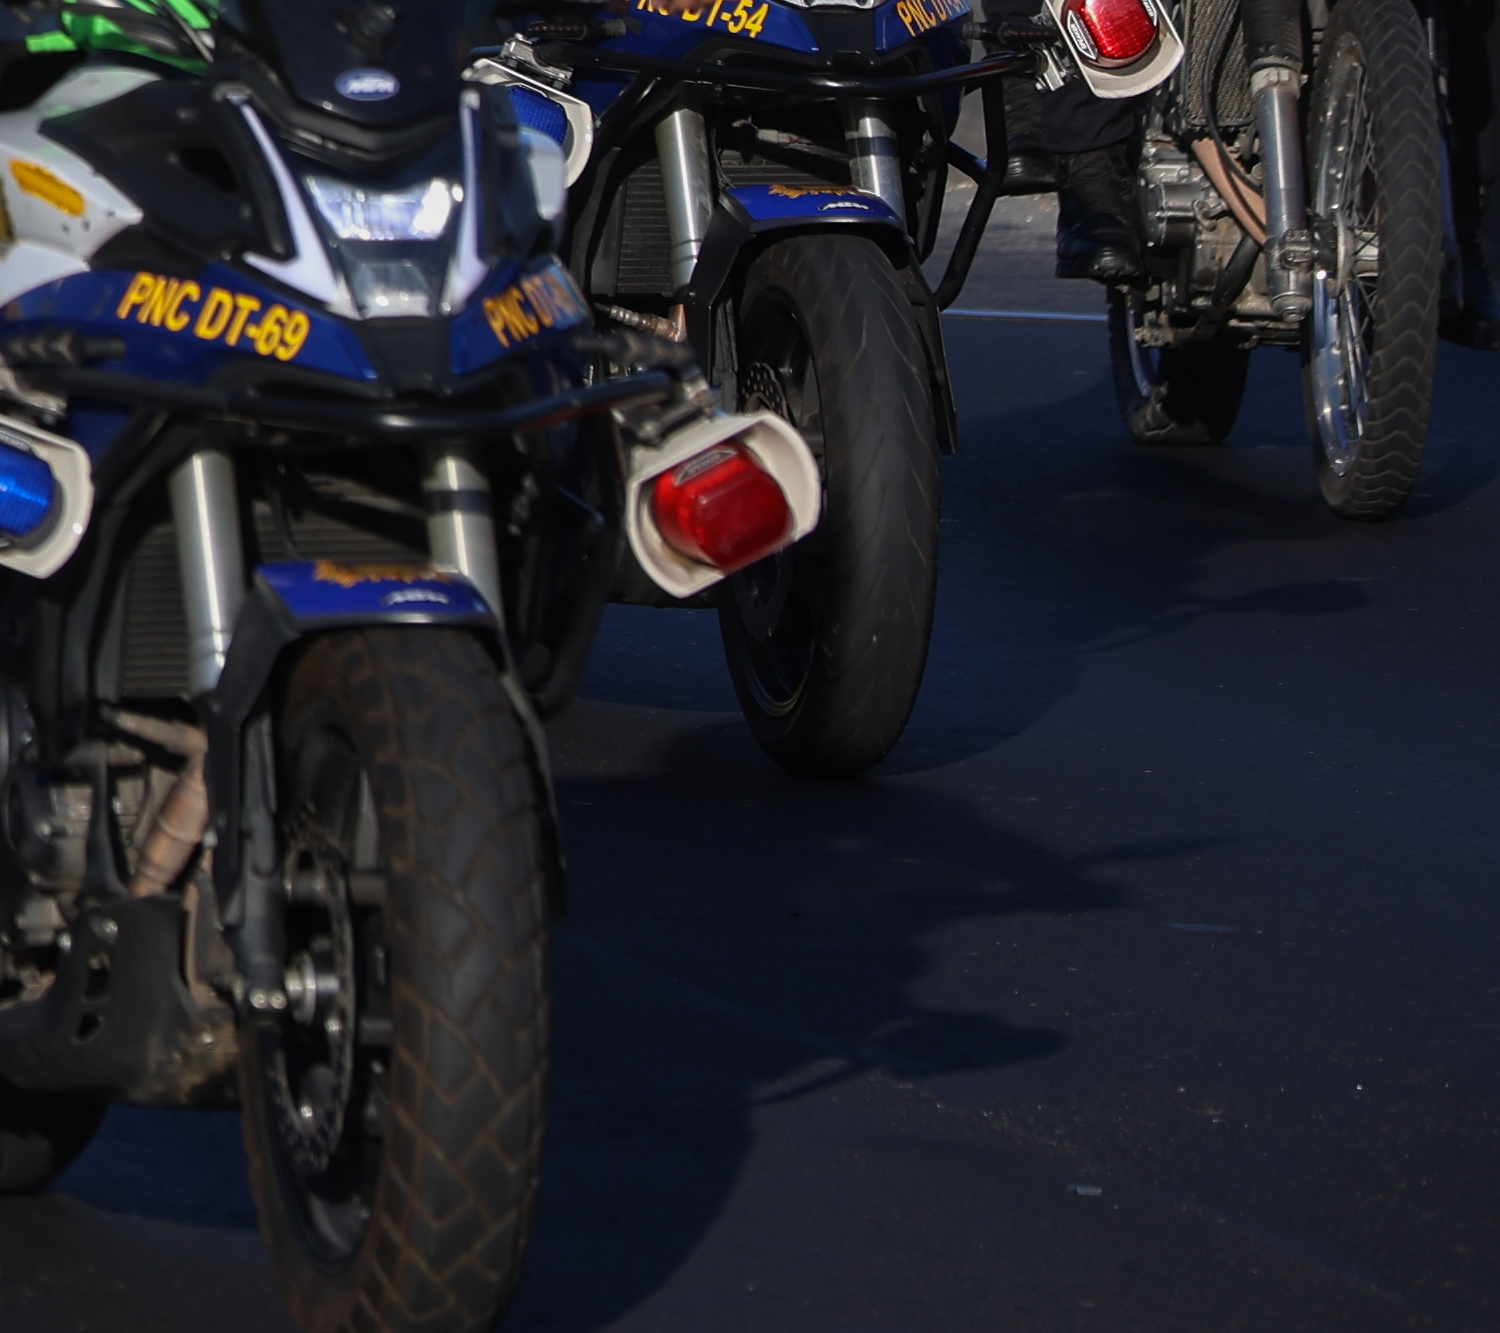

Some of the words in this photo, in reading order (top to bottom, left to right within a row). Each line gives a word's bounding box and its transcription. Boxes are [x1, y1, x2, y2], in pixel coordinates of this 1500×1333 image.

[116, 270, 201, 332] PNC
[193, 286, 311, 362] DT-69
[483, 285, 541, 349] PNC
